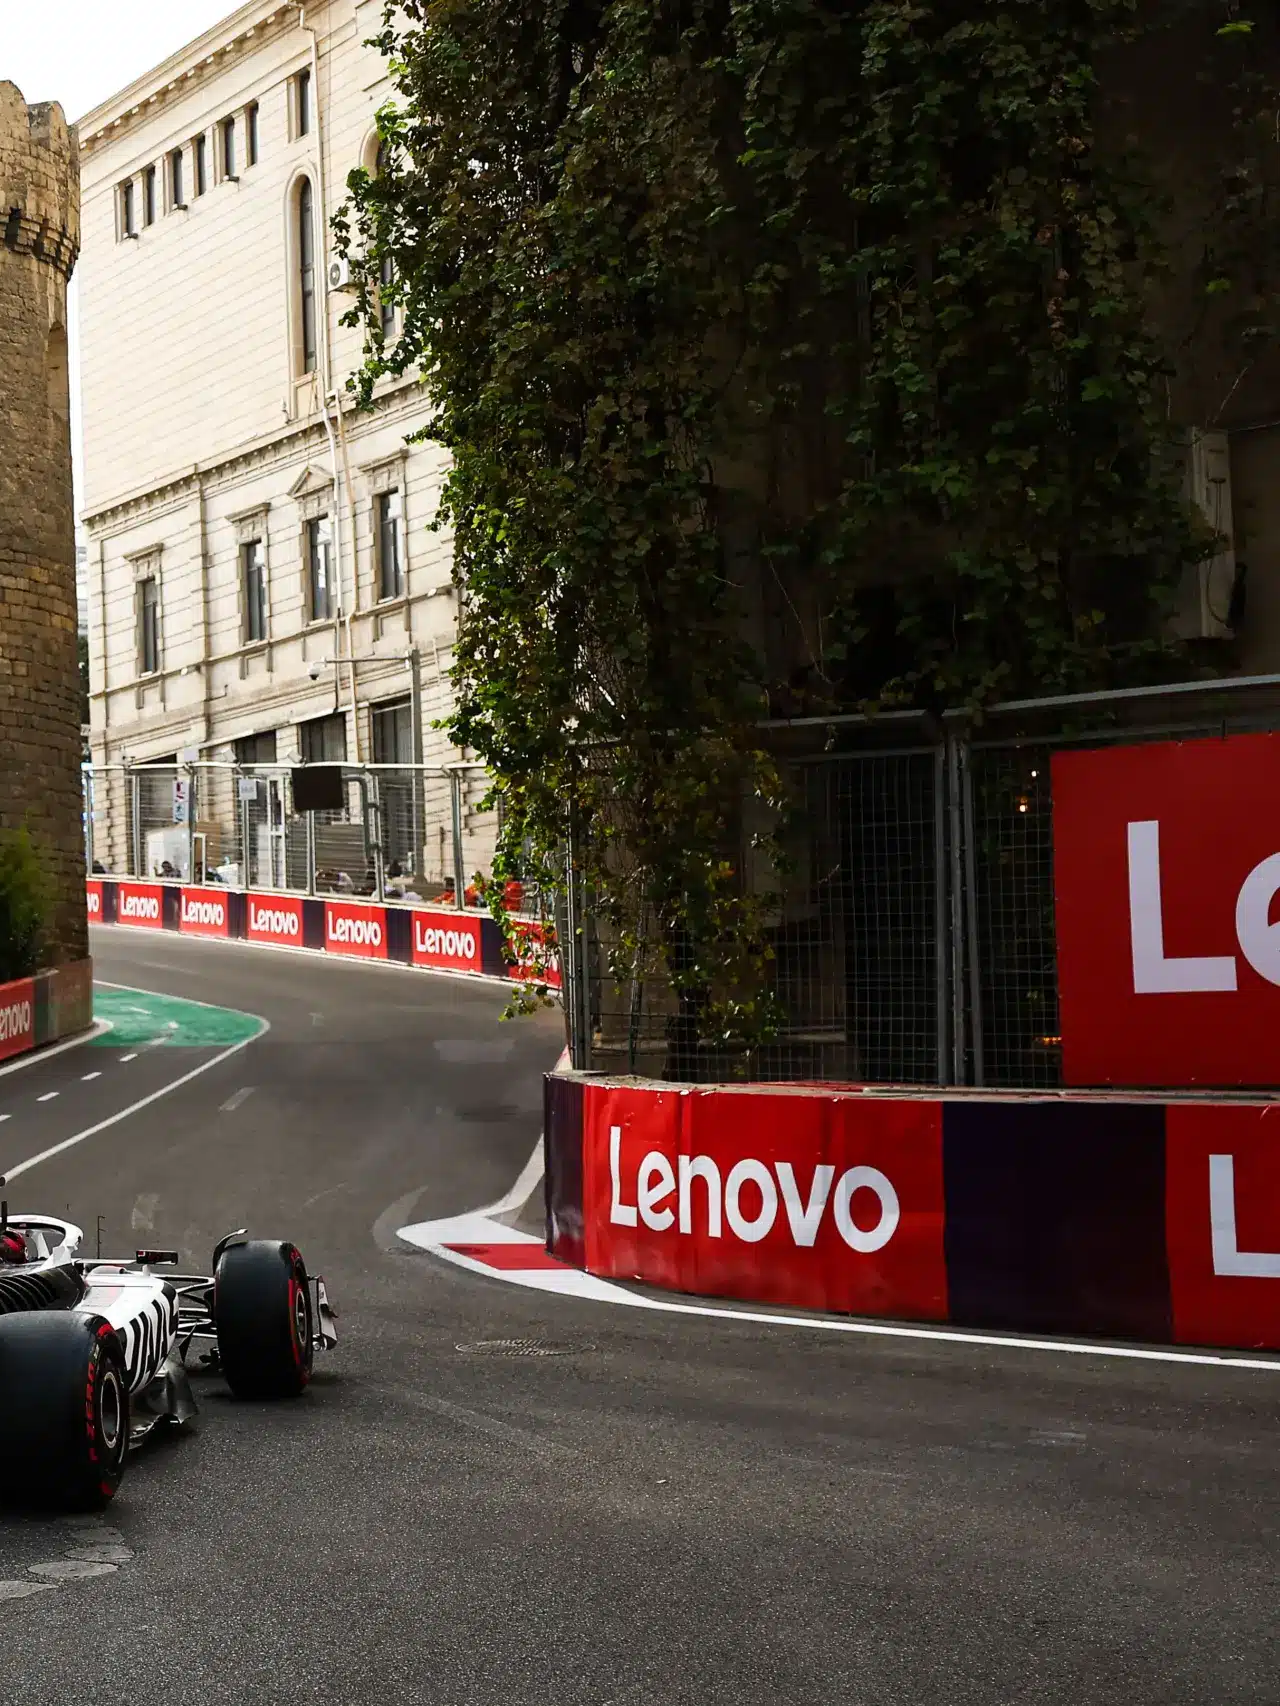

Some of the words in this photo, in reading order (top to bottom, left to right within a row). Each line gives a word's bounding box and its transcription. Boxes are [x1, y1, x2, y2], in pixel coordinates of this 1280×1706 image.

[120, 890, 159, 919] Lenovo
[181, 895, 225, 926] Lenovo
[250, 902, 299, 936] Lenovo
[327, 910, 382, 947] Lenovo
[415, 921, 476, 959] Lenovo
[609, 1125, 900, 1253] Lenovo
